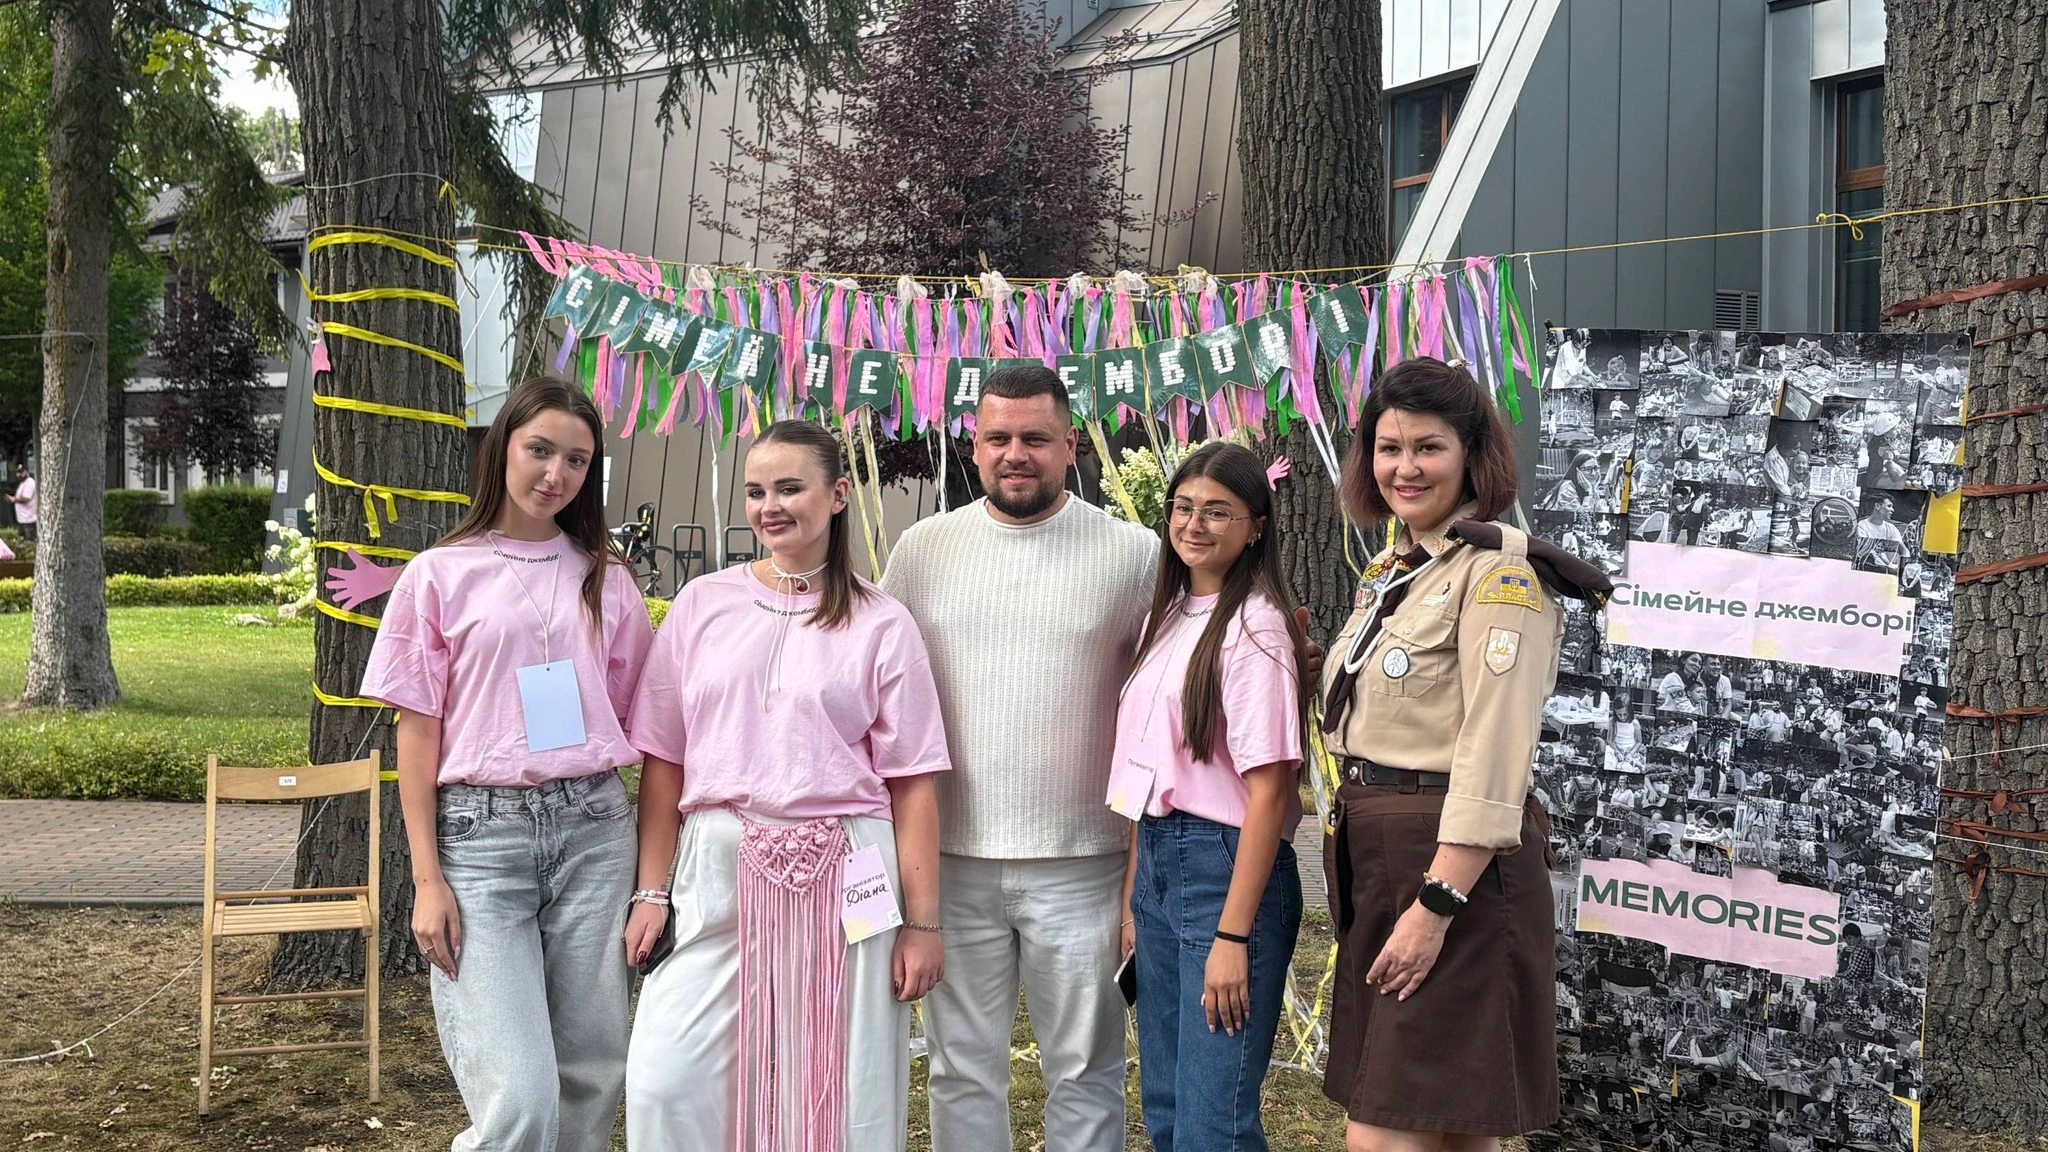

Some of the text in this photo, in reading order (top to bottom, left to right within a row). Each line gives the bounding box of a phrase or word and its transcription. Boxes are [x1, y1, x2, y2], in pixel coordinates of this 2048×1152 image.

[565, 276, 1349, 406] СІМЕЙНЕ ДЕМБОРІ
[1609, 582, 1912, 636] Сімейне джемборі
[846, 883, 888, 907] Діана
[1581, 874, 1838, 946] MEMORIES
